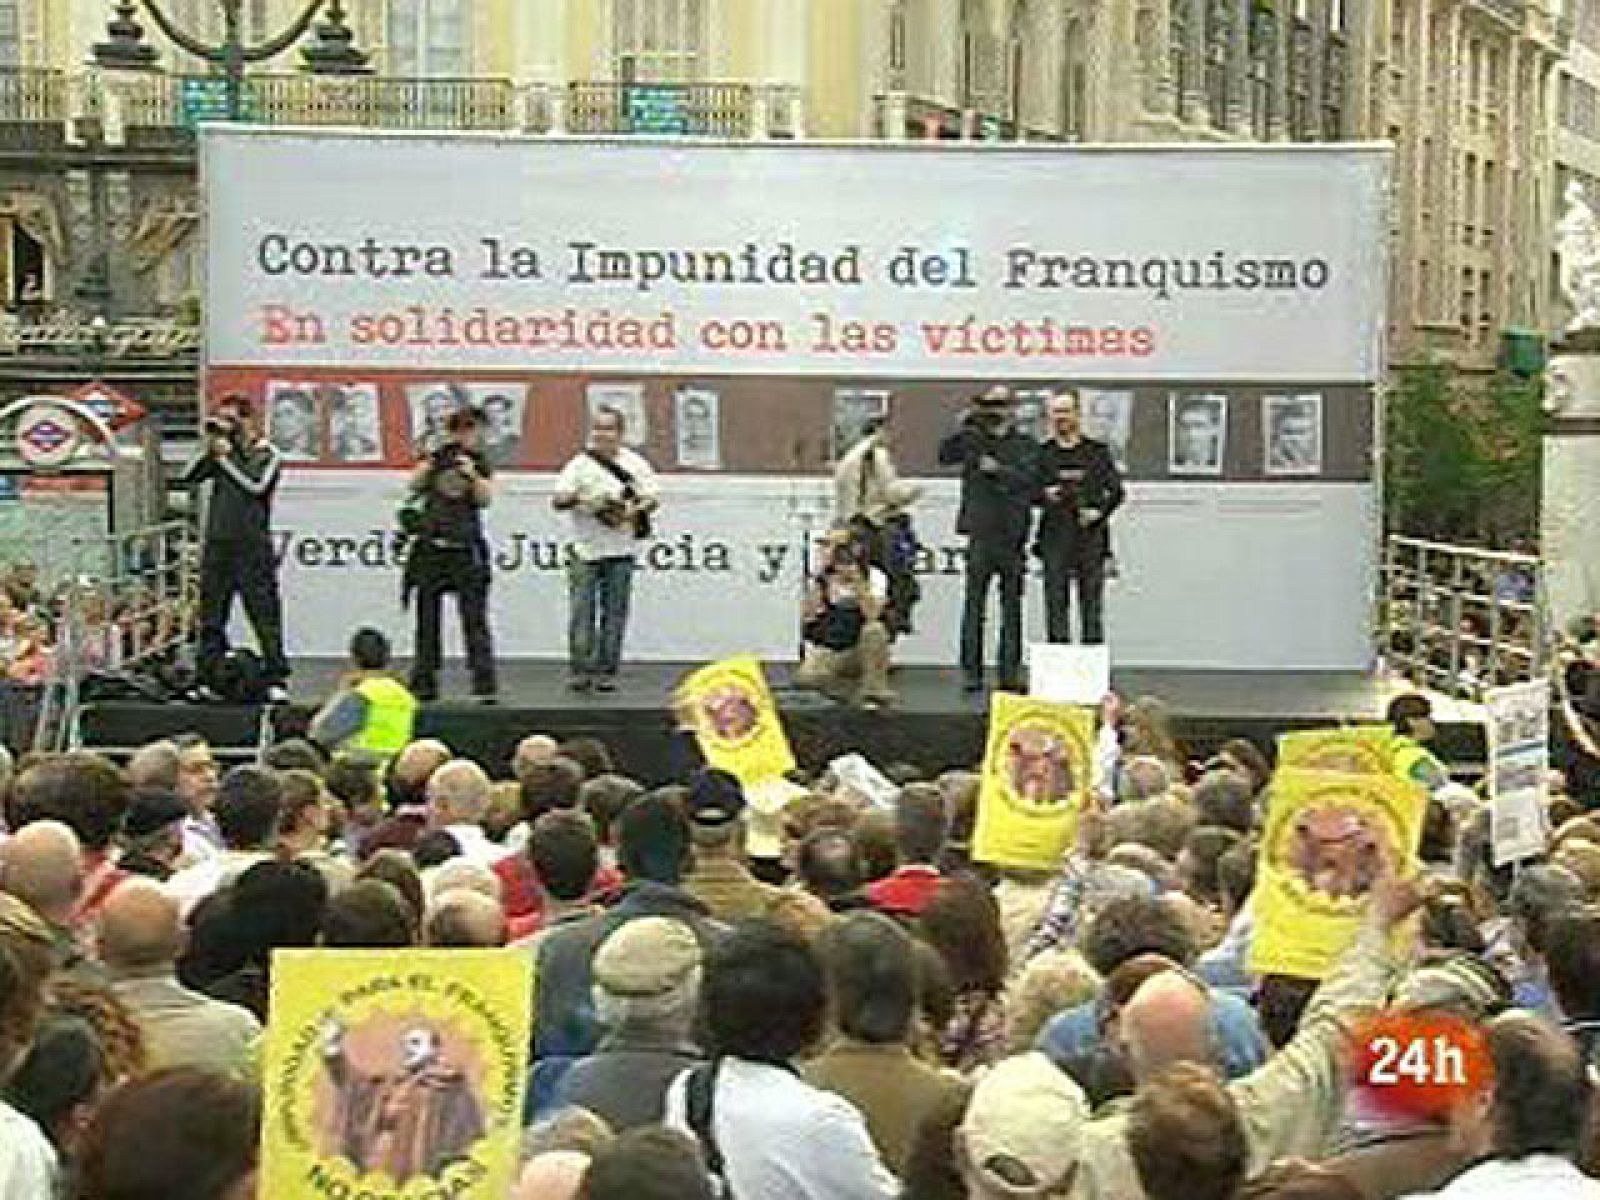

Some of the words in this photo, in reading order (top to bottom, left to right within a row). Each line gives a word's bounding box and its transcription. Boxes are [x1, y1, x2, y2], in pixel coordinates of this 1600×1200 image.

[257, 234, 453, 278] Contra
[481, 239, 541, 279] la
[568, 242, 861, 291] Impunidad
[889, 247, 977, 288] del
[1004, 249, 1329, 299] Franquismo
[259, 305, 326, 345] En
[351, 306, 676, 349] solidaridad
[702, 321, 787, 351] con
[812, 313, 896, 354] las
[922, 315, 1155, 357] víctimas
[758, 544, 788, 583] y
